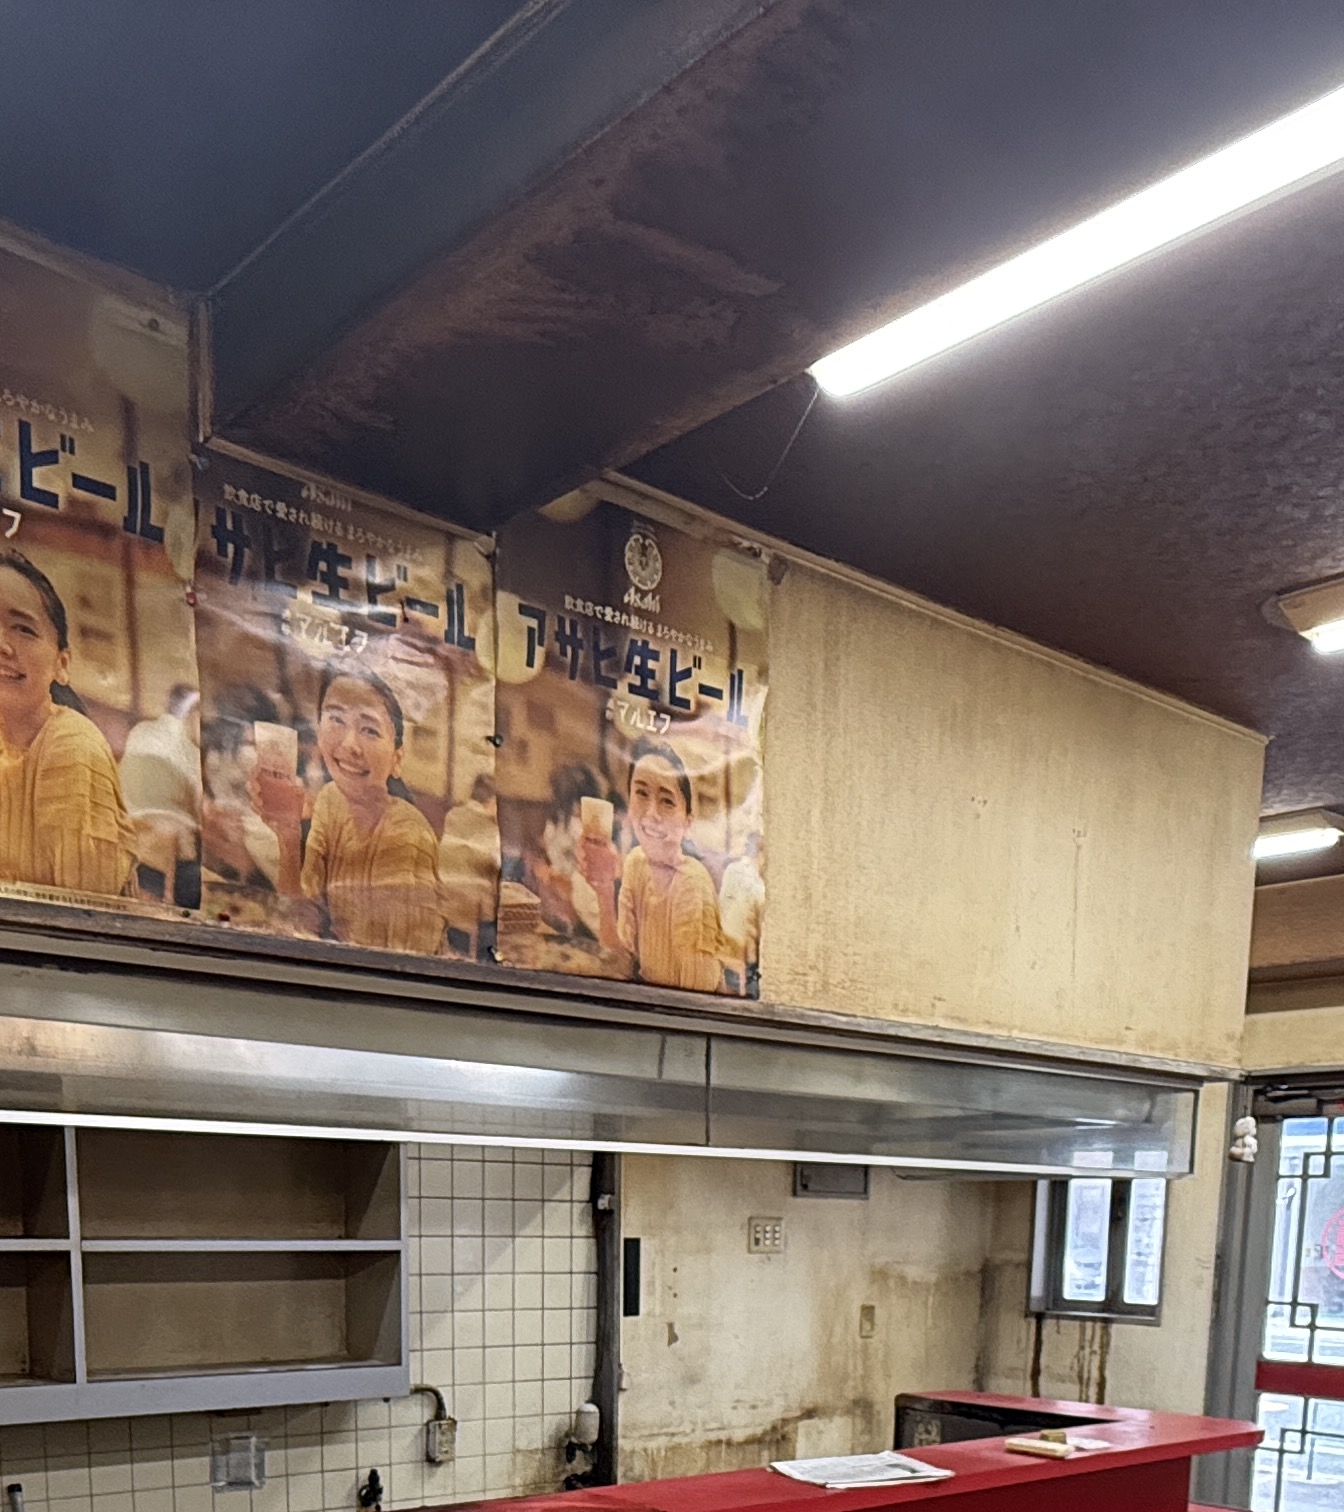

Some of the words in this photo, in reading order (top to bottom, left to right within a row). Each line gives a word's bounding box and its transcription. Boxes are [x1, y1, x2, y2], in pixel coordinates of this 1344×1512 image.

[518, 602, 748, 727] アサヒ生ビール
